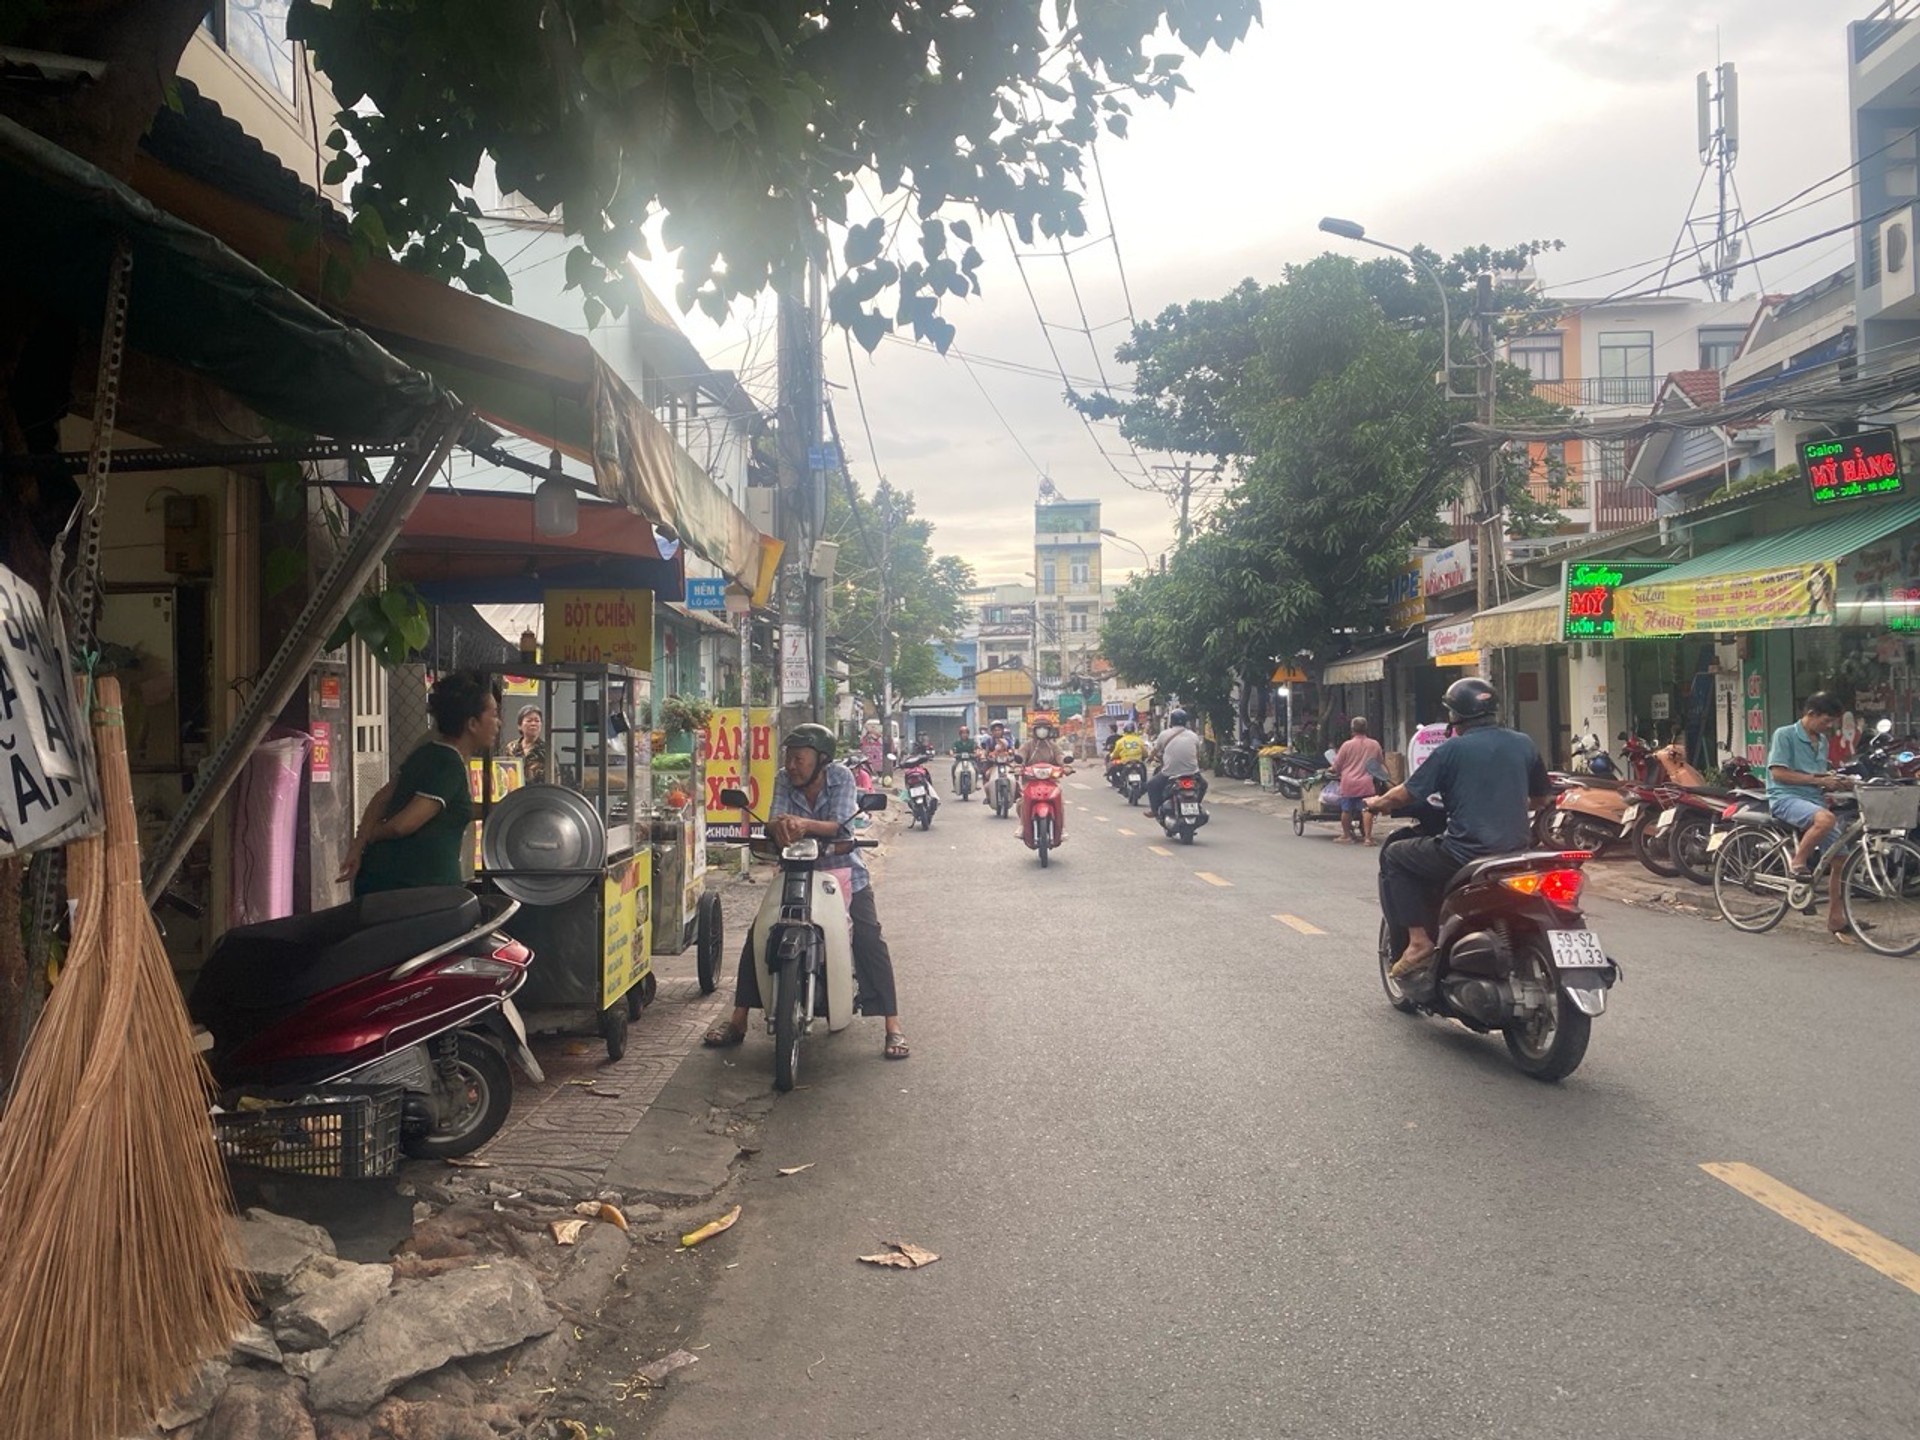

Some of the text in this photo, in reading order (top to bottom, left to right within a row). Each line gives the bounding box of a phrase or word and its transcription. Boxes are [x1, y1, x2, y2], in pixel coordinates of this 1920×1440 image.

[1807, 444, 1843, 457] Salon
[1811, 457, 1838, 487] MỸ
[1573, 566, 1622, 586] Salon
[1571, 587, 1608, 615] MỸ
[1631, 587, 1665, 605] Salon
[564, 595, 591, 634] BỘT
[1571, 616, 1594, 633] UỐN
[1556, 932, 1595, 947] 59-S2
[1556, 949, 1603, 964] 121.33
